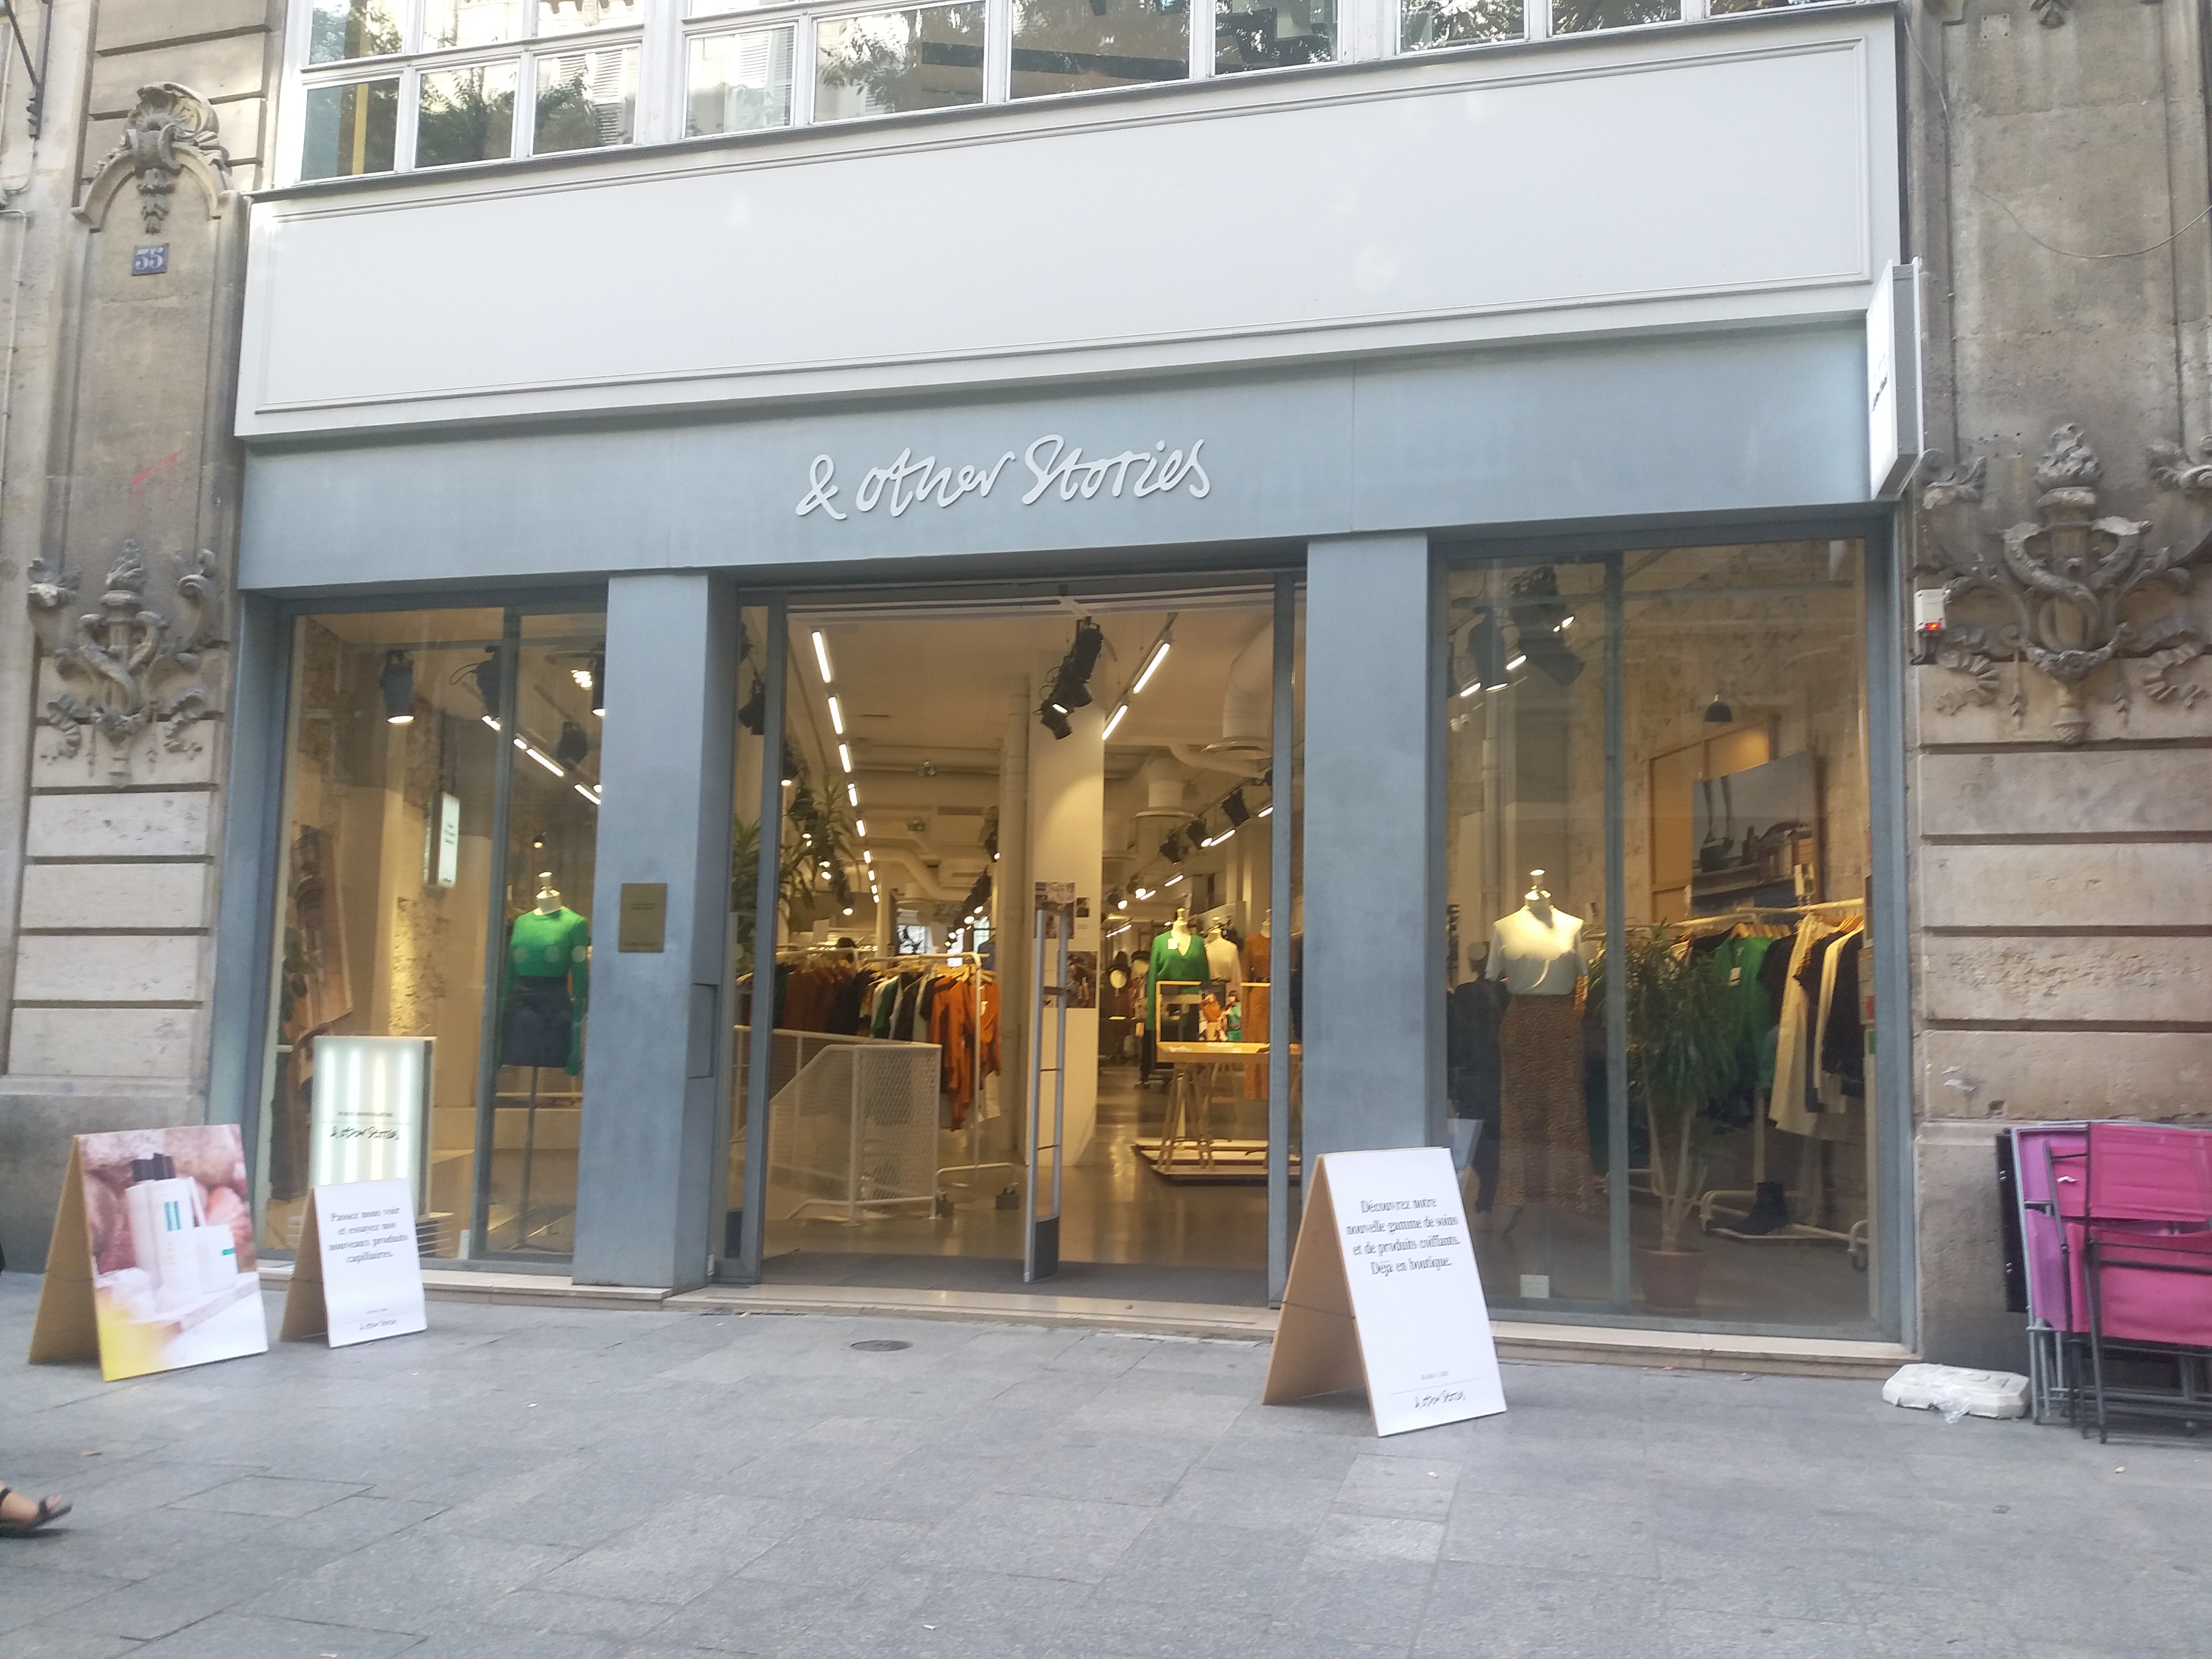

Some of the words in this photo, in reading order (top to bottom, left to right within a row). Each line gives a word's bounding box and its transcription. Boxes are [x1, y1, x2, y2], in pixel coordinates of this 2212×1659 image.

[135, 246, 164, 270] 35
[795, 454, 847, 520] &
[1024, 433, 1211, 505] Stories
[1346, 1220, 1386, 1235] nouvelle
[1387, 1219, 1422, 1235] gamme
[1423, 1215, 1434, 1228] de
[1364, 1241, 1376, 1254] de
[1395, 1262, 1407, 1272] en
